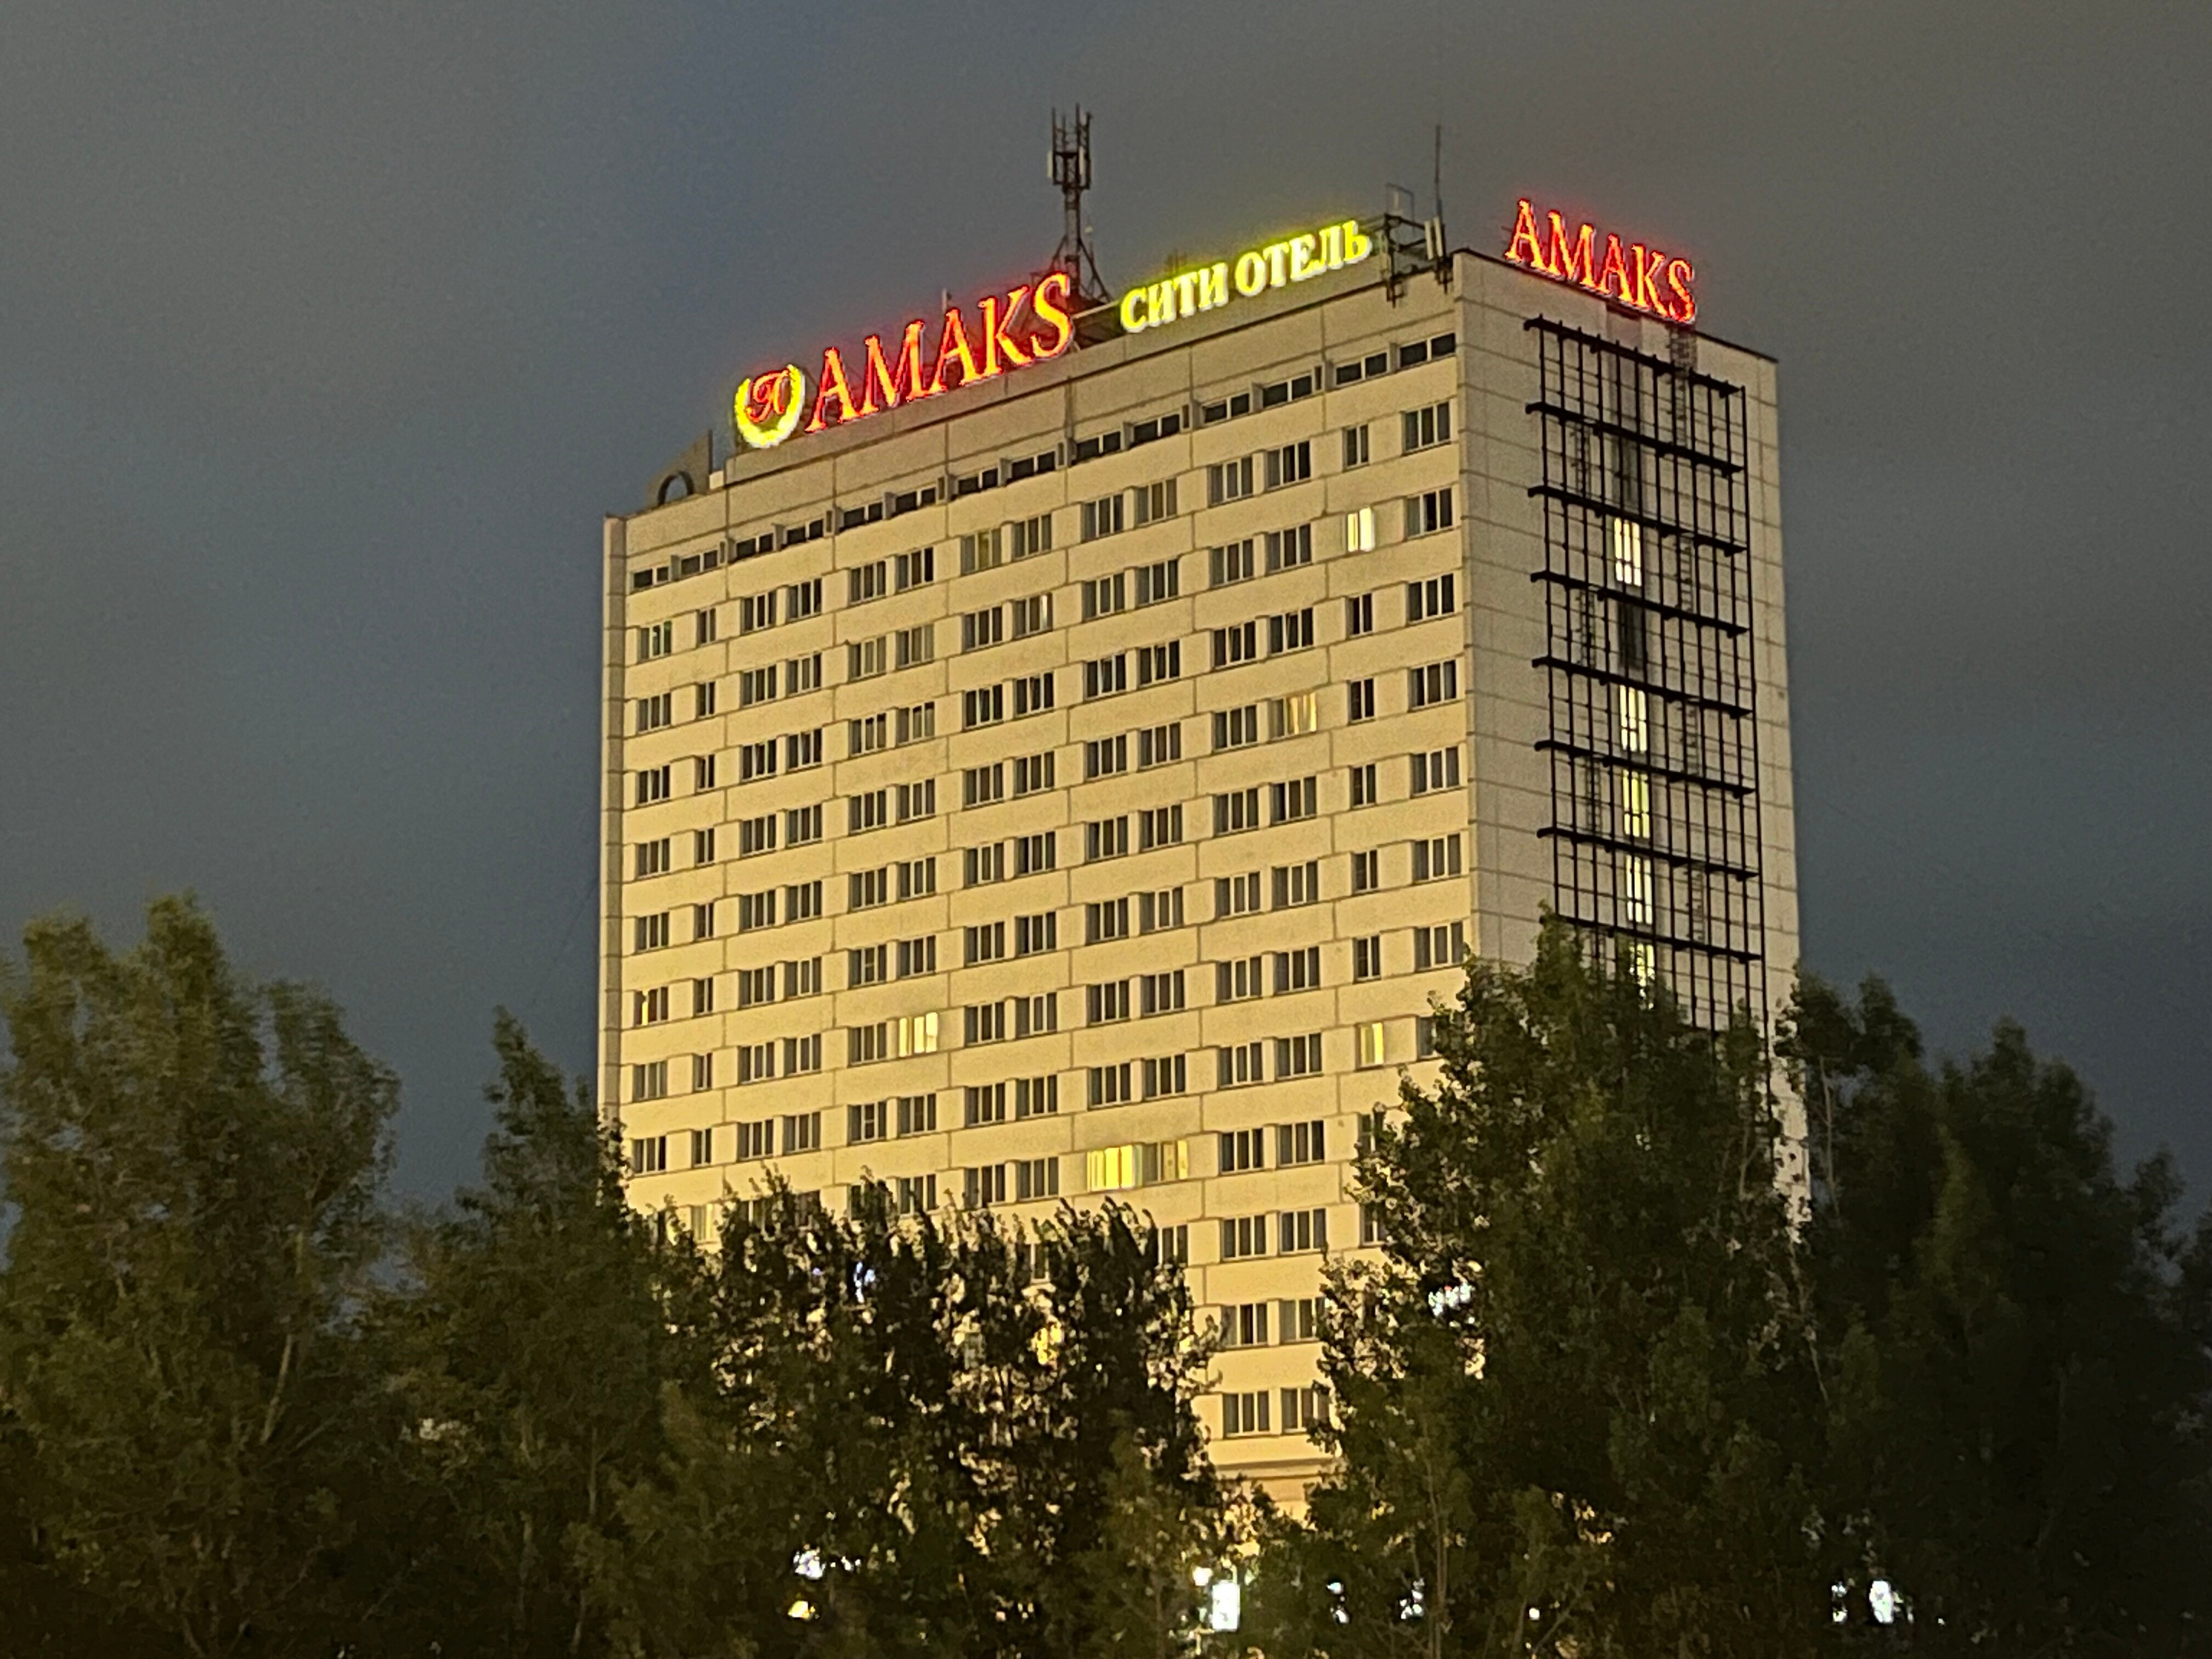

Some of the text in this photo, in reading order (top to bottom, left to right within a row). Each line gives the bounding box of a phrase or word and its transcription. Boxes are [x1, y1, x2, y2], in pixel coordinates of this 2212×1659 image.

[1120, 220, 1372, 332] СИТИ ОТЕЛЬ
[1504, 198, 1696, 323] AMAKS
[804, 270, 1073, 433] AMAKS
